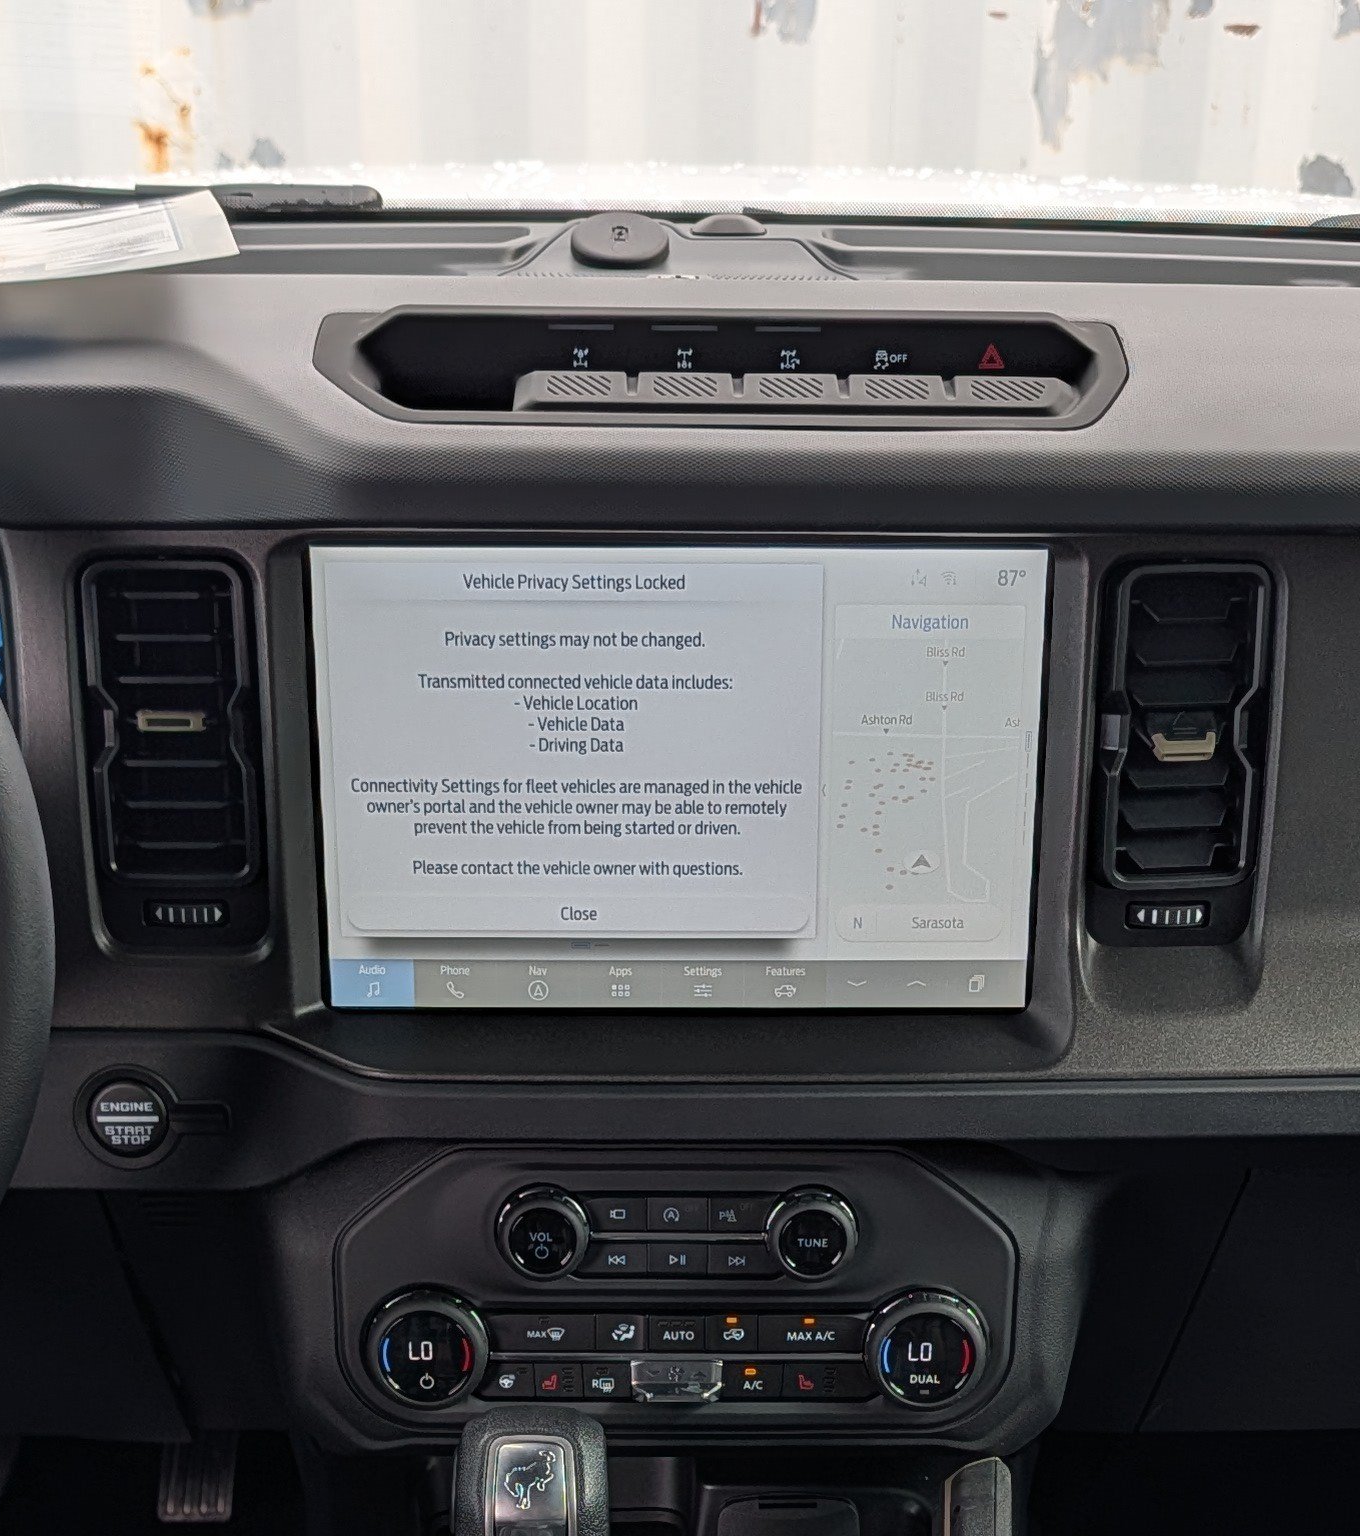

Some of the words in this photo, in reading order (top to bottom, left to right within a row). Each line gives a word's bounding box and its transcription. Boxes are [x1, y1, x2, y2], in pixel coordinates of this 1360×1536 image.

[888, 353, 909, 364] OFF
[462, 573, 515, 590] Vehicle
[517, 573, 569, 593] Privacy
[571, 574, 632, 593] Settings
[635, 574, 686, 590] Locked
[997, 569, 1027, 587] 87°
[891, 614, 969, 633] Navigation
[444, 631, 496, 650] Privacy
[498, 631, 557, 650] settings
[559, 634, 590, 650] may
[593, 632, 618, 647] not
[620, 631, 639, 648] be
[641, 631, 706, 651] changed.
[926, 646, 950, 658] Bliss
[951, 646, 966, 658] Rd
[417, 673, 505, 689] Transmitted
[507, 673, 582, 690] connected
[583, 674, 633, 690] vehicle
[635, 674, 669, 690] data
[671, 674, 733, 690] includes:
[522, 694, 574, 711] Vehicle
[576, 695, 638, 711] Location
[925, 691, 949, 702] Bliss
[950, 691, 965, 702] Rd
[537, 716, 588, 732] Vehicle
[590, 716, 625, 732] Data
[860, 714, 898, 726] Ashton
[899, 714, 913, 726] Rd
[538, 737, 587, 756] Driving
[590, 737, 624, 753] Data
[350, 777, 439, 796] Connectivity
[441, 778, 500, 797] Settings
[502, 778, 523, 794] for
[525, 778, 558, 794] fleet
[560, 778, 616, 794] vehicles
[618, 782, 641, 794] are
[643, 778, 710, 797] managed
[712, 779, 725, 795] in
[728, 779, 752, 795] the
[754, 779, 803, 795] vehicle
[366, 798, 421, 814] owner's
[423, 798, 467, 817] portal
[468, 798, 496, 814] and
[498, 798, 522, 814] the
[524, 798, 573, 814] vehicle
[575, 802, 619, 815] owner
[621, 803, 652, 817] may
[654, 799, 672, 815] be
[674, 799, 705, 815] able
[707, 800, 722, 815] to
[725, 799, 788, 818] remotely
[413, 820, 468, 837] prevent
[469, 819, 494, 835] the
[496, 819, 545, 835] vehicle
[547, 819, 581, 835] from
[583, 819, 622, 838] being
[624, 819, 675, 835] started
[677, 823, 692, 835] or
[694, 820, 741, 836] driven.
[412, 859, 458, 875] Please
[460, 861, 514, 875] contact
[516, 859, 541, 875] the
[542, 860, 591, 875] vehicle
[593, 864, 637, 876] owner
[638, 860, 670, 876] with
[672, 861, 743, 879] questions.
[560, 906, 598, 921] Close
[853, 916, 863, 930] N
[911, 916, 965, 929] Sarasota
[358, 964, 386, 975] Audio
[440, 965, 471, 976] Phone
[528, 965, 548, 976] Nav
[608, 965, 633, 978] Apps
[683, 965, 725, 978] Settings
[765, 965, 806, 977] Features
[100, 1102, 154, 1112] ENGINE
[104, 1125, 154, 1136] START
[111, 1135, 151, 1145] STOP
[528, 1232, 553, 1243] VOL
[797, 1238, 829, 1248] TUNE
[526, 1330, 547, 1338] MAX
[662, 1330, 695, 1341] AUTO
[786, 1331, 813, 1341] MAX
[815, 1330, 835, 1342] A/C
[743, 1380, 763, 1391] A/C
[909, 1374, 941, 1385] DUAL
